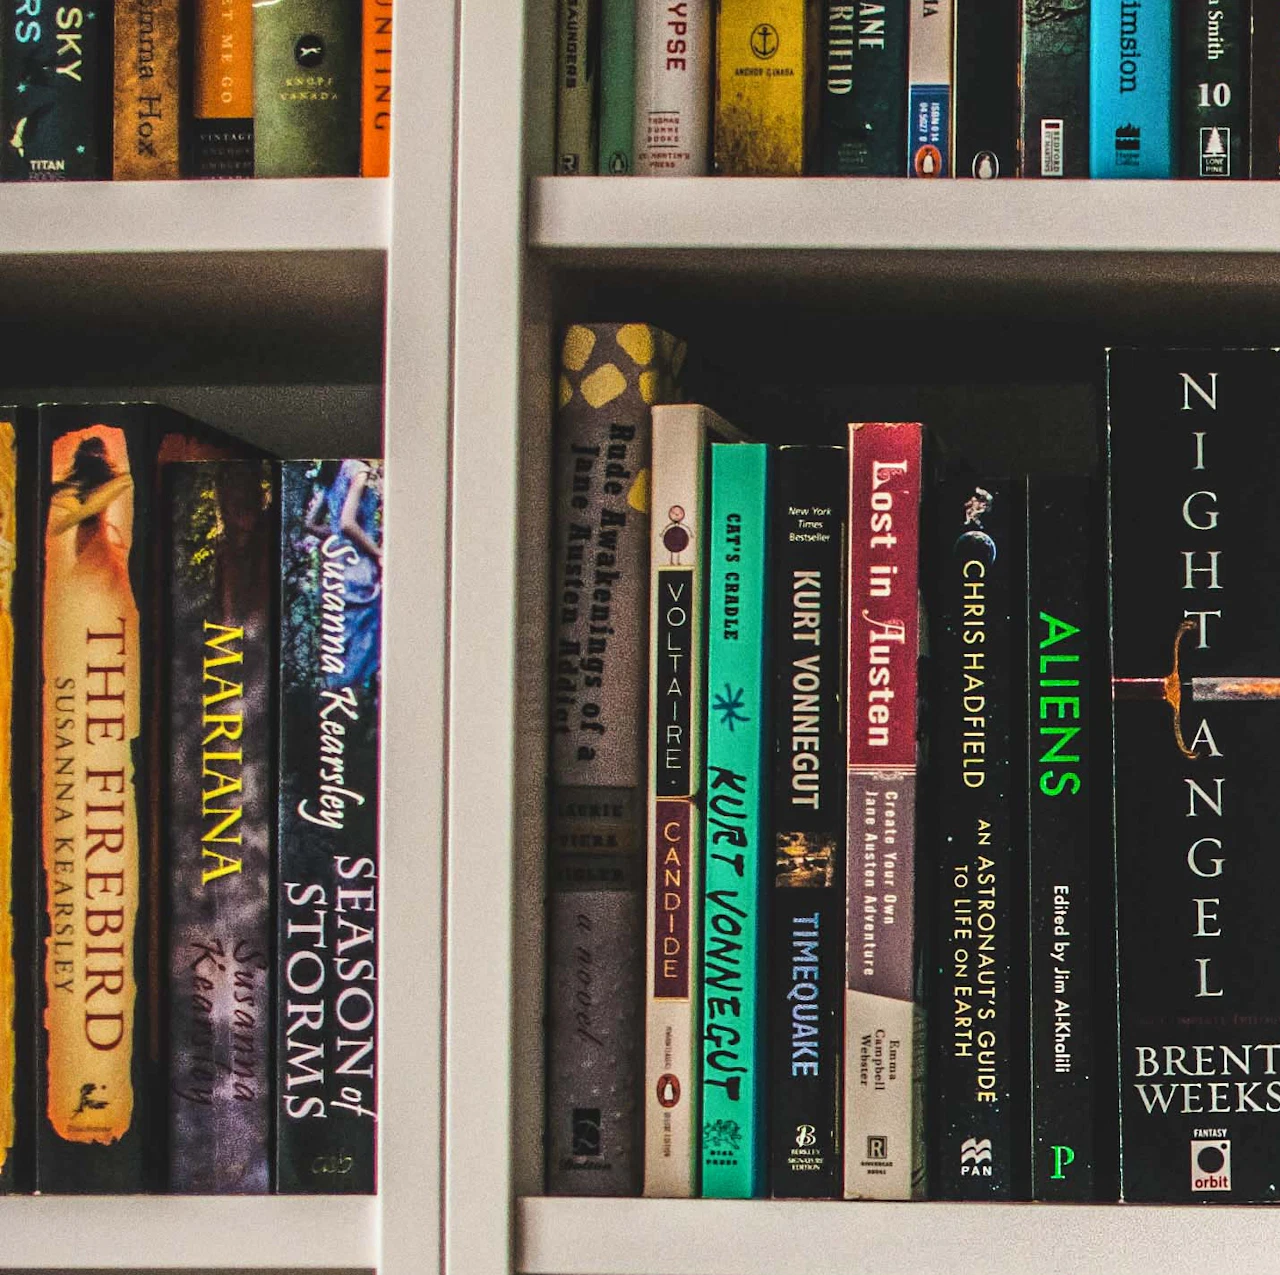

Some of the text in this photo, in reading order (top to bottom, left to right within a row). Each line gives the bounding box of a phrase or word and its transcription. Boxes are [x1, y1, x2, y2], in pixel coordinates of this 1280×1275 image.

[56, 7, 83, 82] SKY
[221, 35, 233, 104] ME GO
[1198, 82, 1231, 107] 10
[1207, 11, 1224, 60] Smith
[30, 160, 65, 170] TITAN
[722, 512, 743, 642] CAT'S CRADLE
[860, 459, 908, 747] Lost in Austen
[792, 569, 820, 809] KURT VONNEGUT
[961, 559, 988, 789] CHRIS HADFIELD
[1037, 611, 1081, 798] ALIENS
[200, 618, 243, 886] MARIANA
[52, 677, 76, 995] SUSANNA KEARSLEY
[81, 617, 126, 1052] THE FIREBIRD
[702, 766, 747, 1102] KURT VONNEGUT
[790, 912, 820, 1077] TIMEQUAKE
[952, 865, 973, 1059] TO LIFE ON EARTH
[975, 819, 997, 1103] AN ASTRONAUT'S GUIDE
[1047, 884, 1075, 1073] Edited by Jim Al-Khalili
[858, 1033, 873, 1087] Webster
[871, 1028, 887, 1092] Campbell
[888, 1039, 901, 1082] Emma
[1192, 1128, 1229, 1139] FANTASY
[960, 1165, 993, 1177] PAN
[1193, 1176, 1231, 1190] orbit
